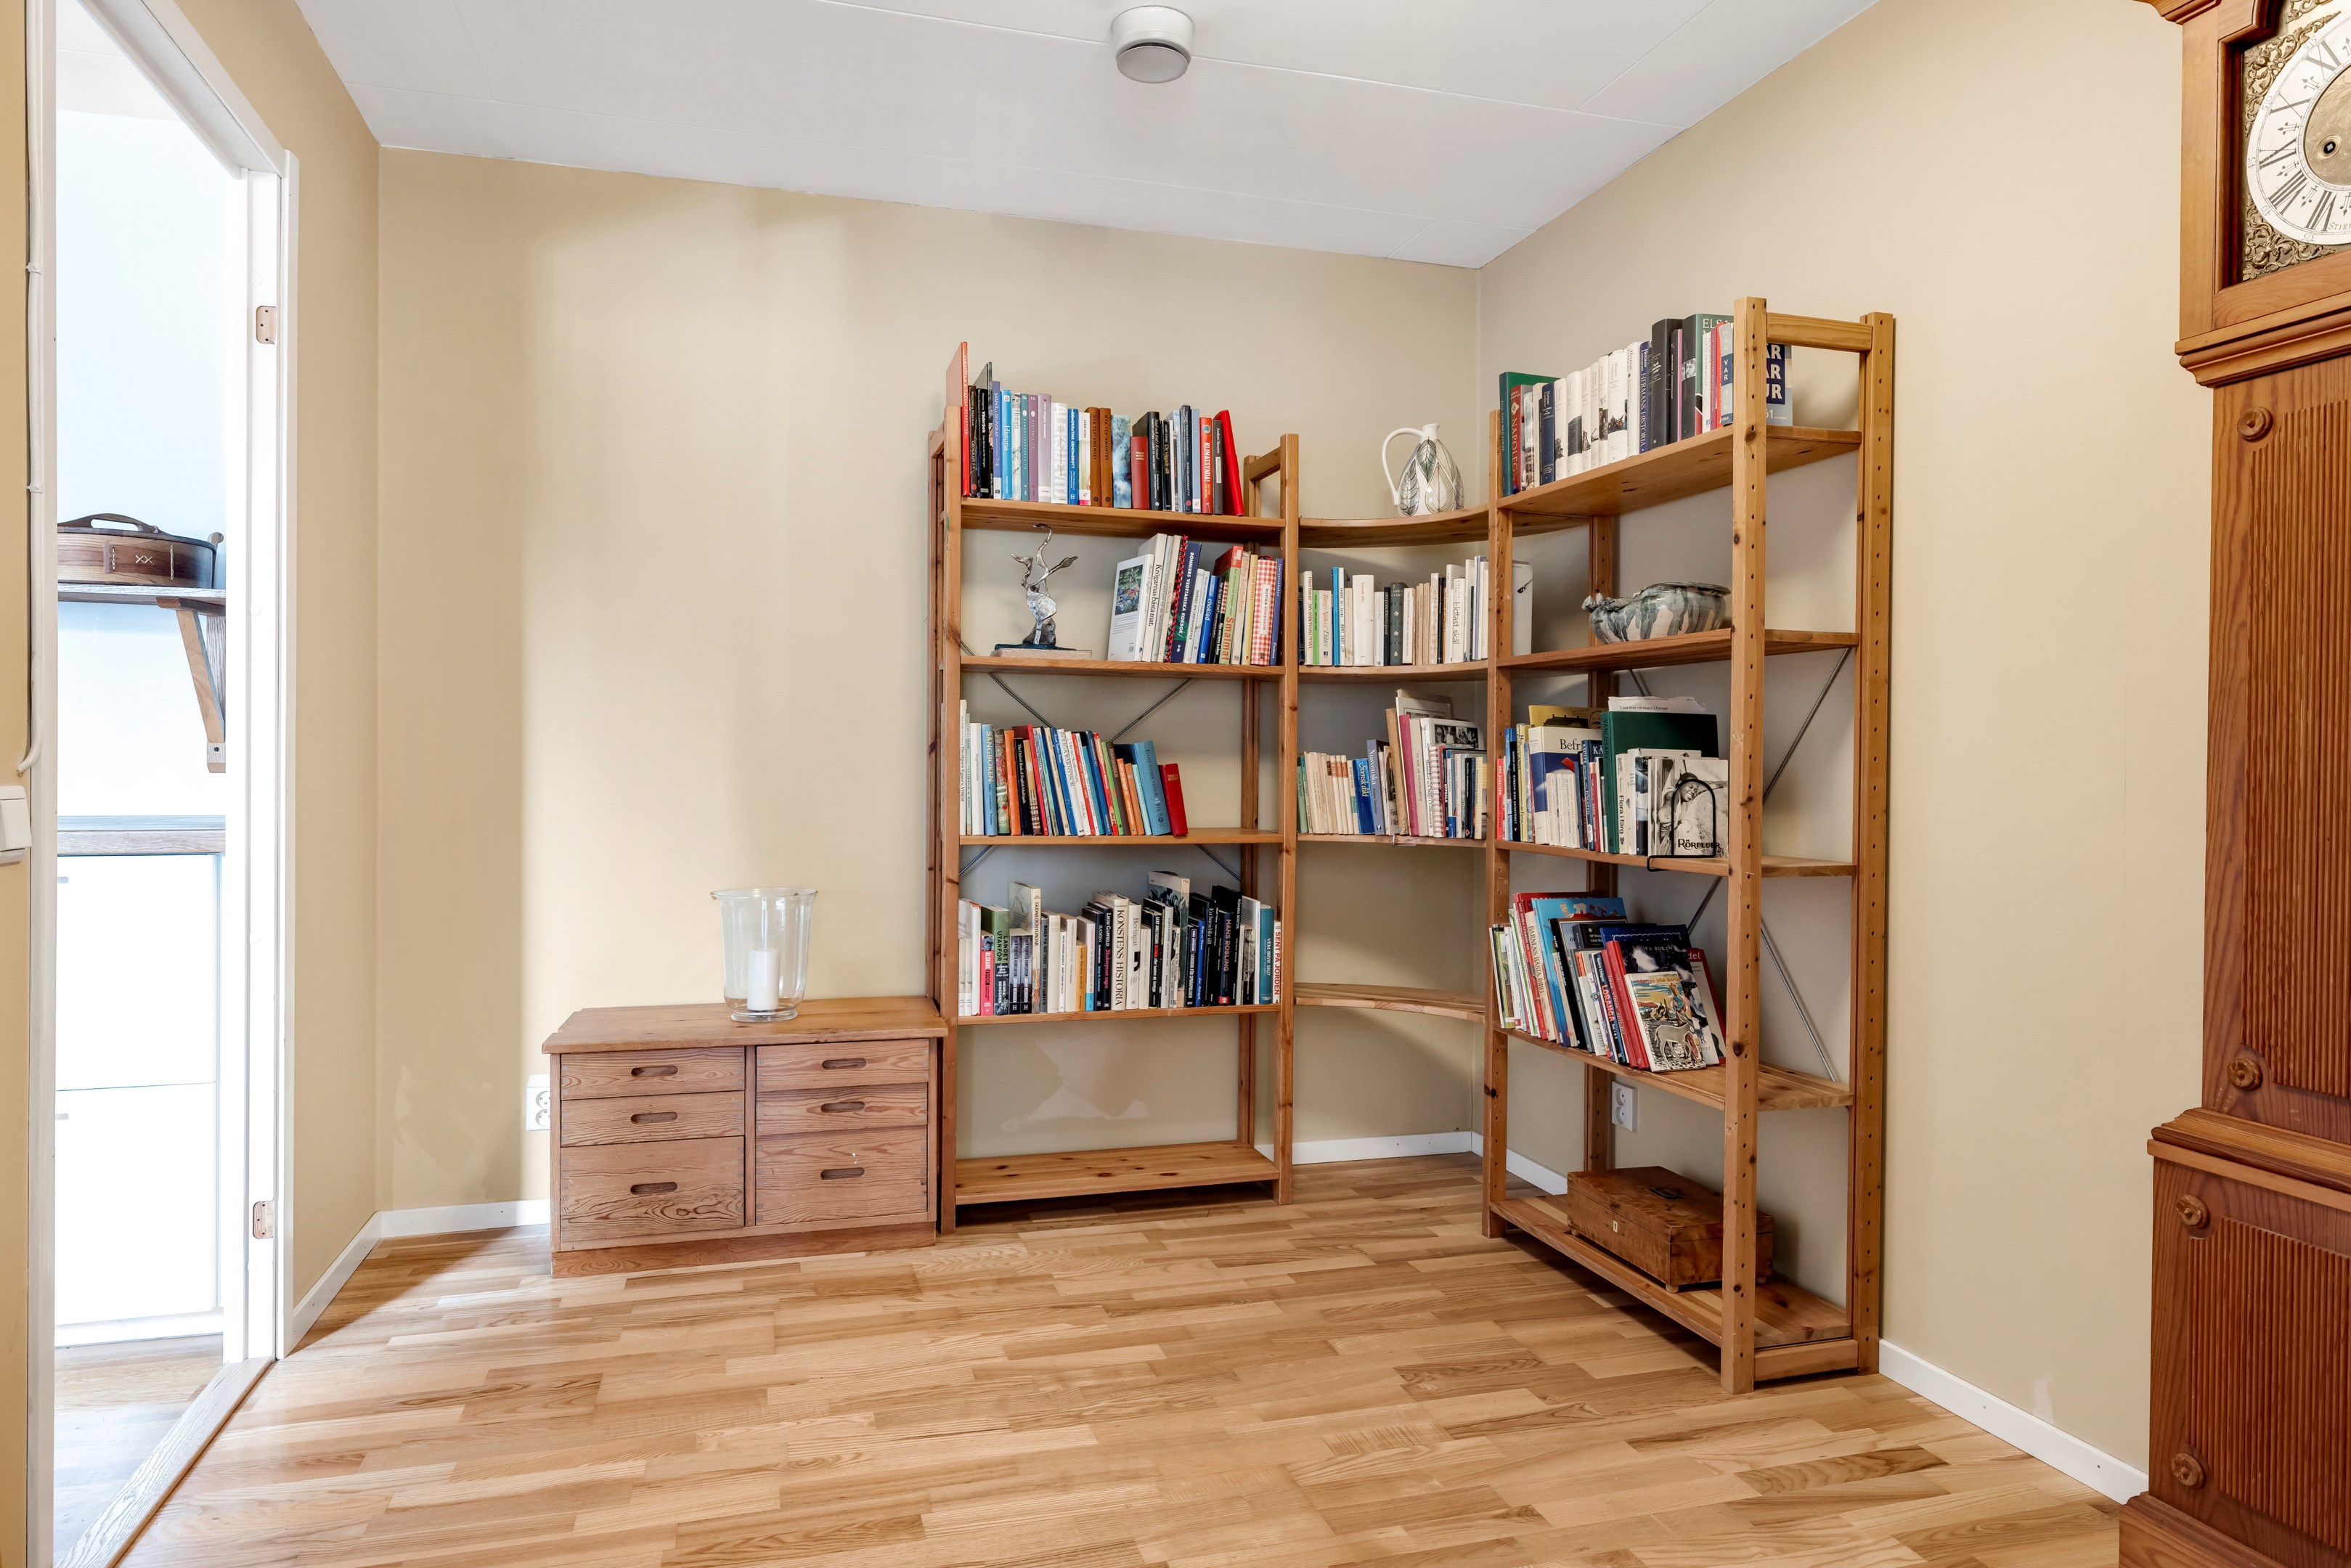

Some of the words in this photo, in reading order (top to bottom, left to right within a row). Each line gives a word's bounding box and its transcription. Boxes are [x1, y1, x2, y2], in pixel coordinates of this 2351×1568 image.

[2268, 90, 2312, 119] X
[1186, 552, 1195, 578] BONNIERS
[1152, 564, 1162, 597] Krögarnas
[1181, 579, 1191, 611] VEGETARISKA
[1149, 597, 1158, 613] bästa
[1205, 598, 1213, 621] choklad
[1221, 617, 1235, 661] Smalmat
[1358, 762, 1368, 785] Svensk
[1368, 749, 1378, 785] Nusvenska
[1116, 910, 1125, 959] KONSTENS
[1130, 918, 1139, 947] Bevingat
[1528, 926, 1539, 955] BARNENS
[1274, 952, 1281, 961] PÅ
[1115, 962, 1124, 1006] HISTORIA
[1601, 984, 1615, 1022] LORANGA
